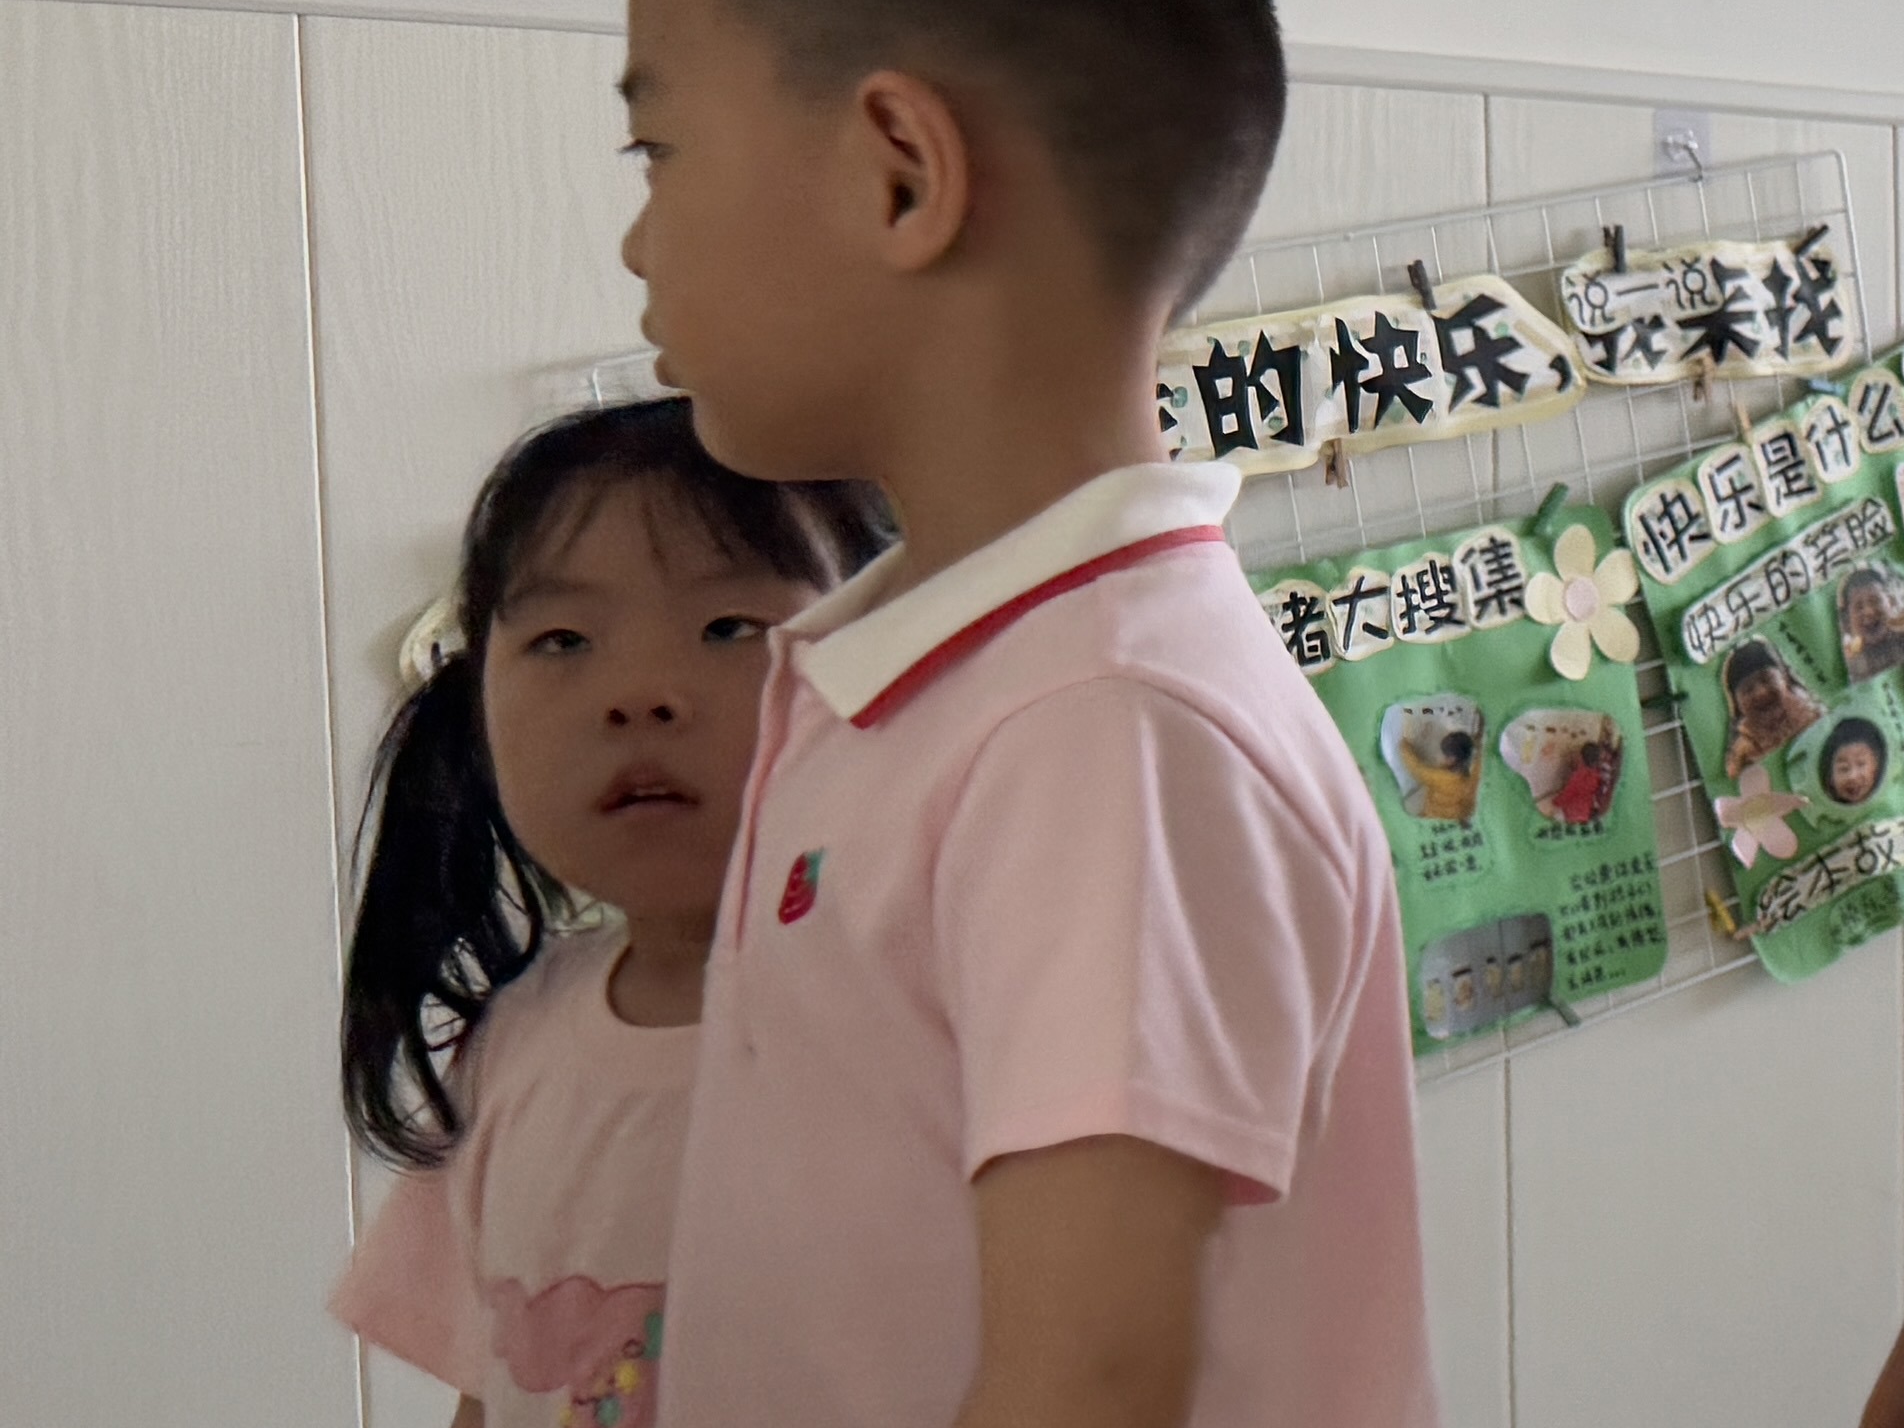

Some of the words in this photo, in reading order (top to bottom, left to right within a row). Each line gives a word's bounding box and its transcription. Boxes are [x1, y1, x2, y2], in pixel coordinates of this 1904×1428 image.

[1682, 497, 1893, 658] 快乐的笑脸
